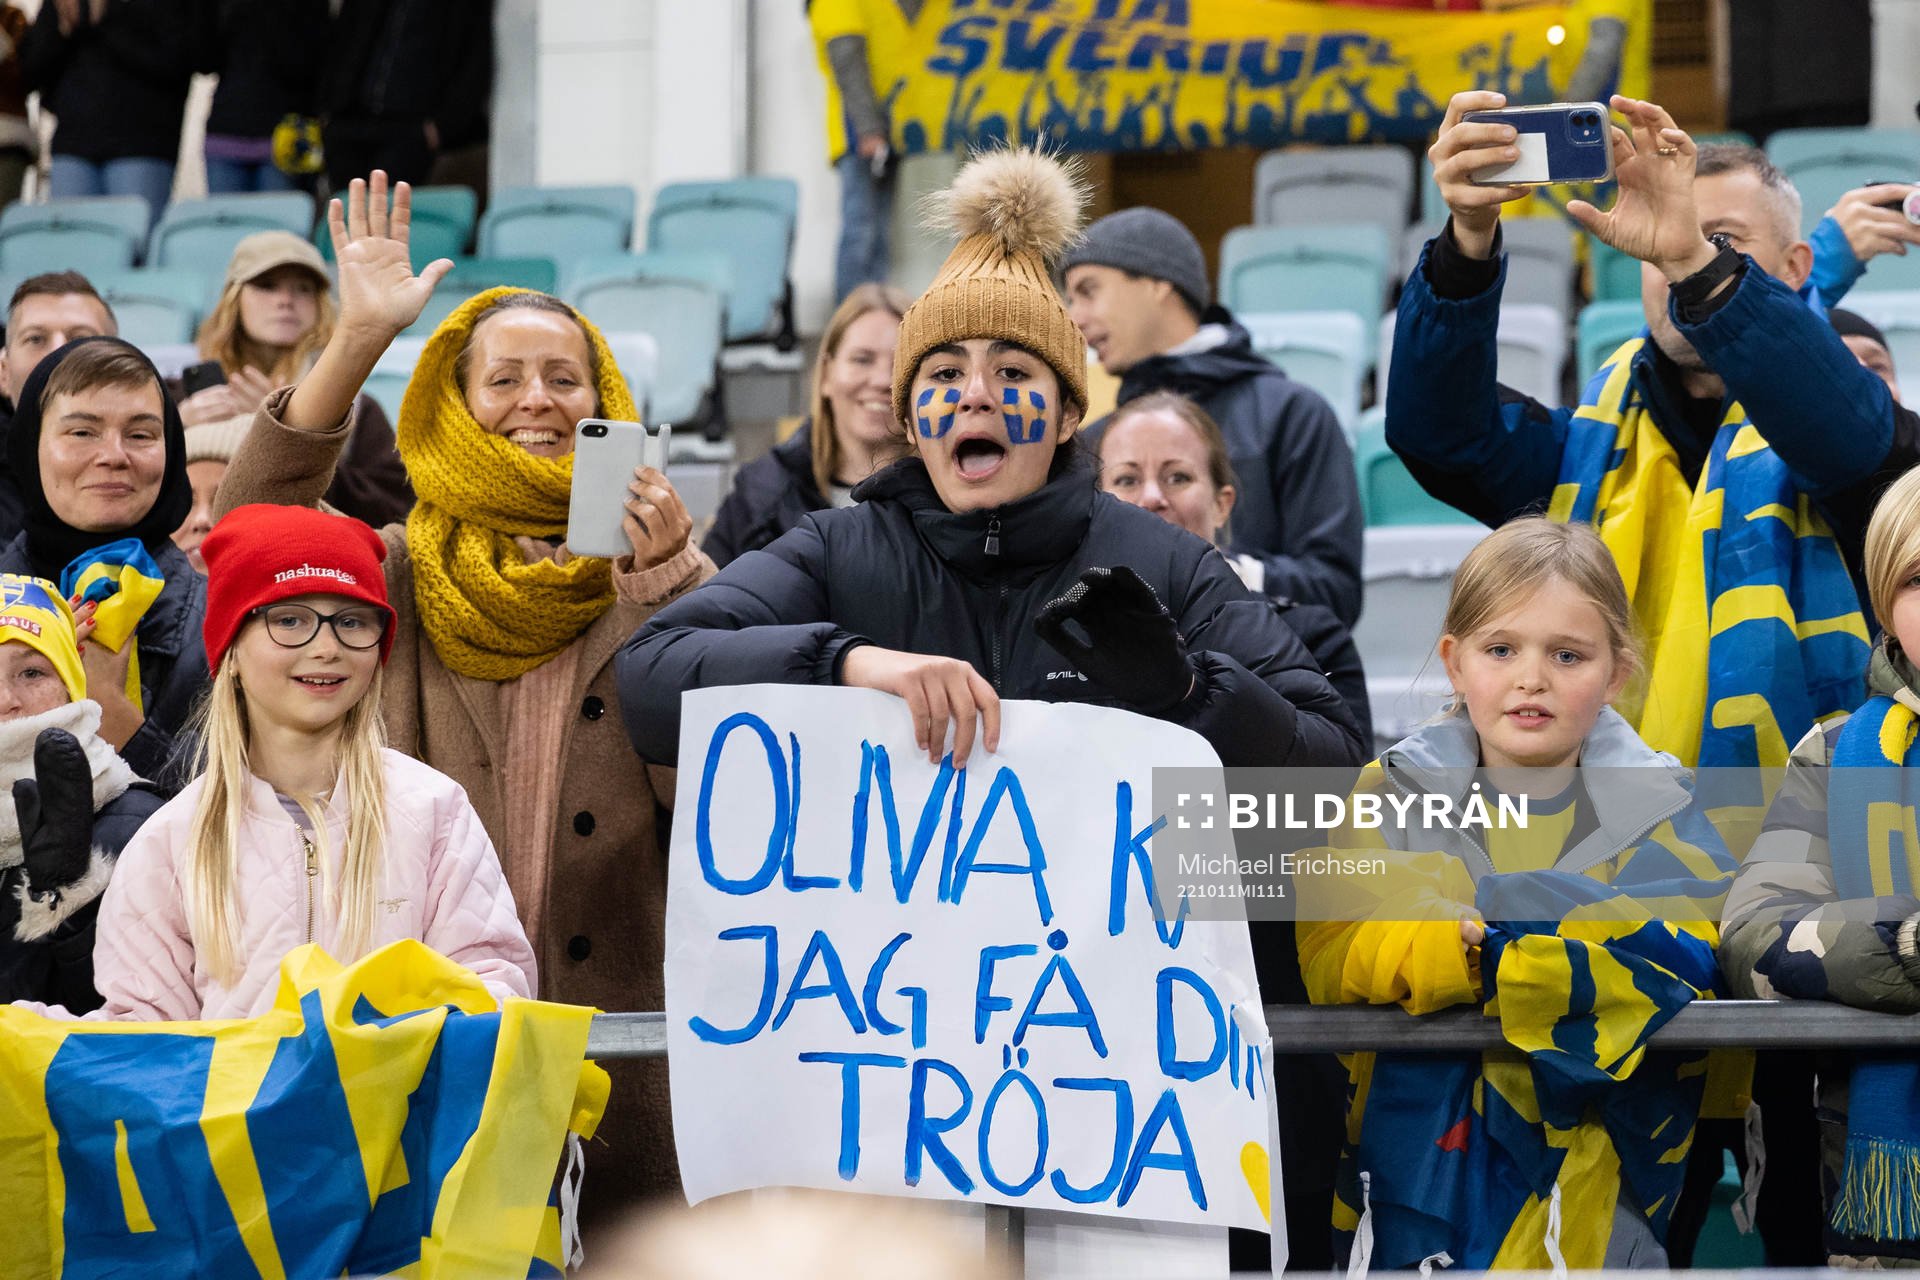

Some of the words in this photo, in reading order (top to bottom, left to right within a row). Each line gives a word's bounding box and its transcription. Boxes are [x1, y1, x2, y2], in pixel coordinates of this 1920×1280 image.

[695, 711, 1055, 928] OLIVIA
[688, 925, 929, 1050] JAG
[973, 928, 1109, 1060] FÅ
[798, 1043, 1209, 1212] TRÖJA
